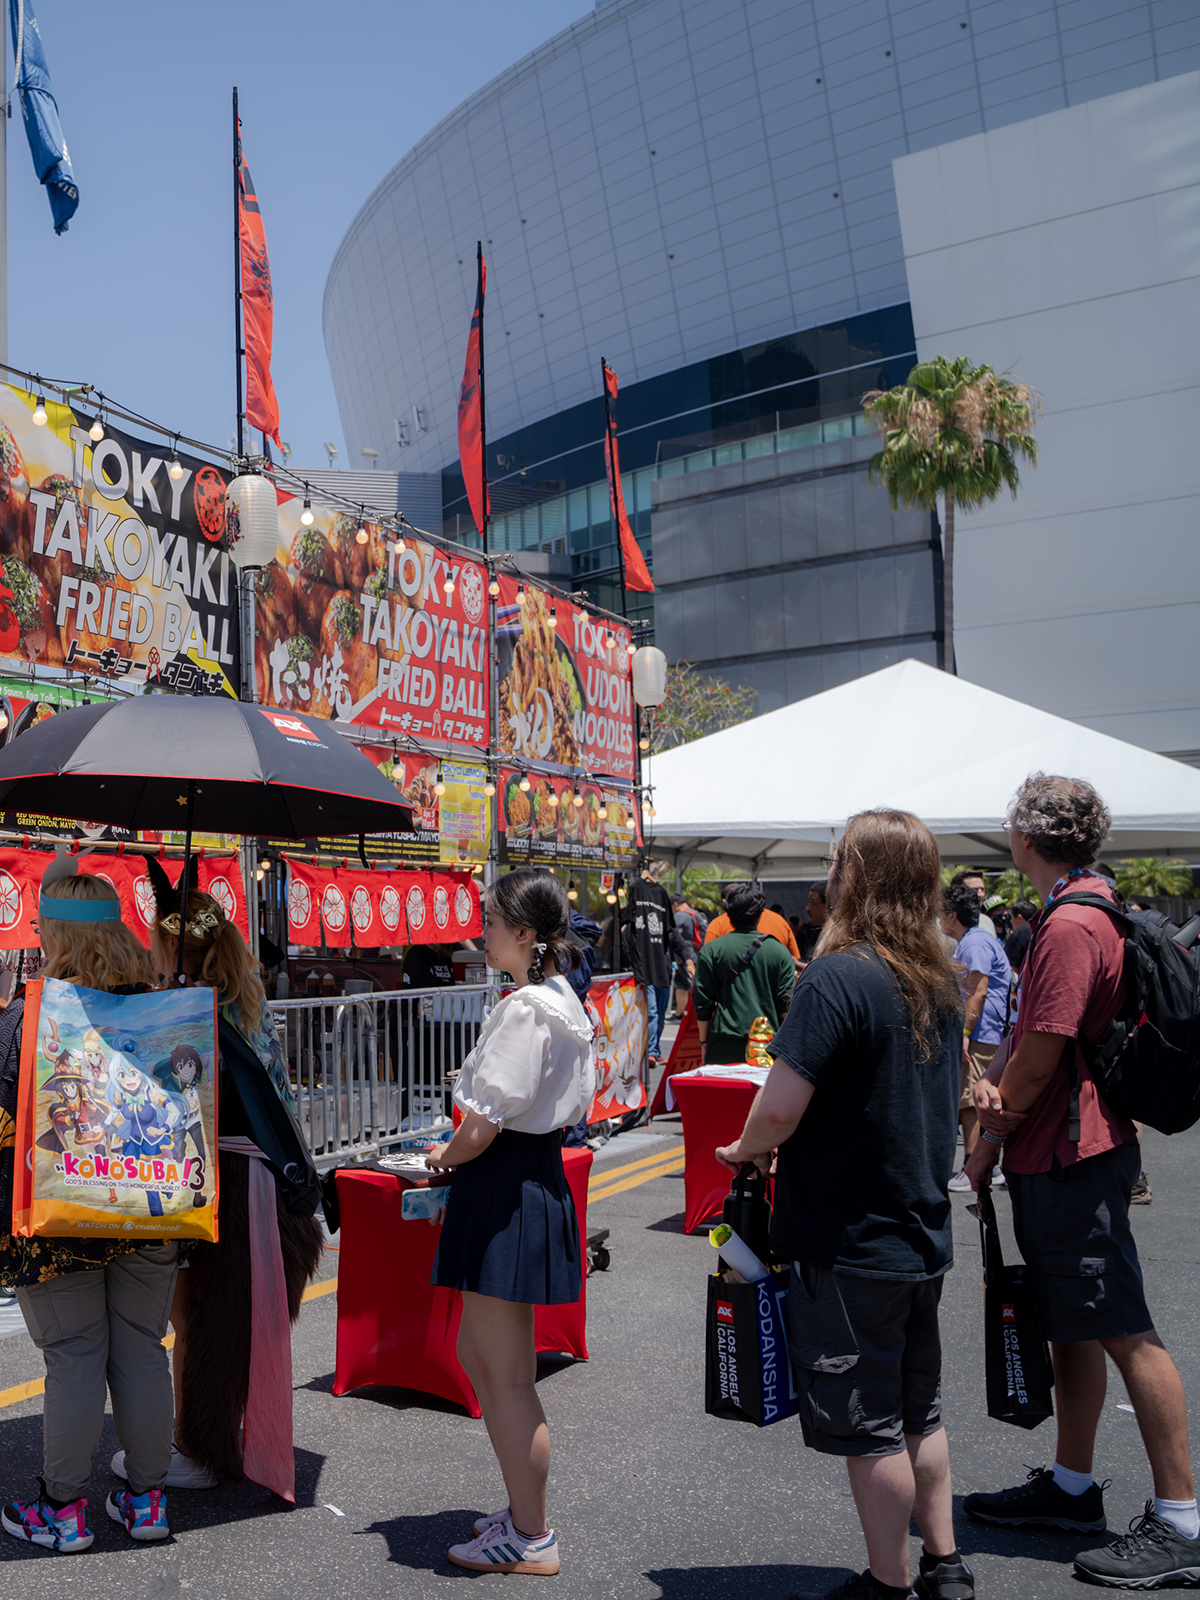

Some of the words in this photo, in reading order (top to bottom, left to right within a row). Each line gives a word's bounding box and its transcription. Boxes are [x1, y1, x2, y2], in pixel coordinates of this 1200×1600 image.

[29, 487, 230, 606] TAKOYAKI
[56, 574, 154, 645] FRIED
[161, 601, 234, 666] BALL
[360, 593, 486, 673] TAKOYAKI
[65, 639, 148, 676] トーキョー
[3, 687, 26, 699] Sauce,
[26, 690, 39, 701] Egg
[39, 692, 58, 704] Yolk,
[376, 657, 437, 709] FRIED
[440, 672, 486, 719] BALL
[586, 665, 631, 717] UDON
[378, 706, 433, 733] トーキョー
[442, 718, 484, 743] タコヤキ
[573, 708, 633, 756] NOODLES
[440, 764, 461, 775] TOKYO
[462, 766, 486, 778] LEMON
[470, 791, 485, 799] MENU
[17, 818, 36, 826] GREEN
[37, 819, 59, 829] ONION,
[59, 821, 76, 830] MAYO
[65, 1178, 83, 1186] GOD'S
[83, 1179, 109, 1188] BLESSING
[130, 1182, 161, 1191] WONDERFUL
[77, 1221, 107, 1229] WATCH
[135, 1223, 180, 1232] crunchyroll
[717, 1306, 733, 1318] AX
[1003, 1308, 1014, 1317] AX
[726, 1328, 736, 1354] LOS
[757, 1282, 778, 1420] KODANSHA
[1010, 1328, 1019, 1351] LOS
[717, 1327, 729, 1400] CALIFORNIA
[1003, 1328, 1015, 1397] CALIFORNIA
[1012, 1352, 1028, 1404] ANGELES
